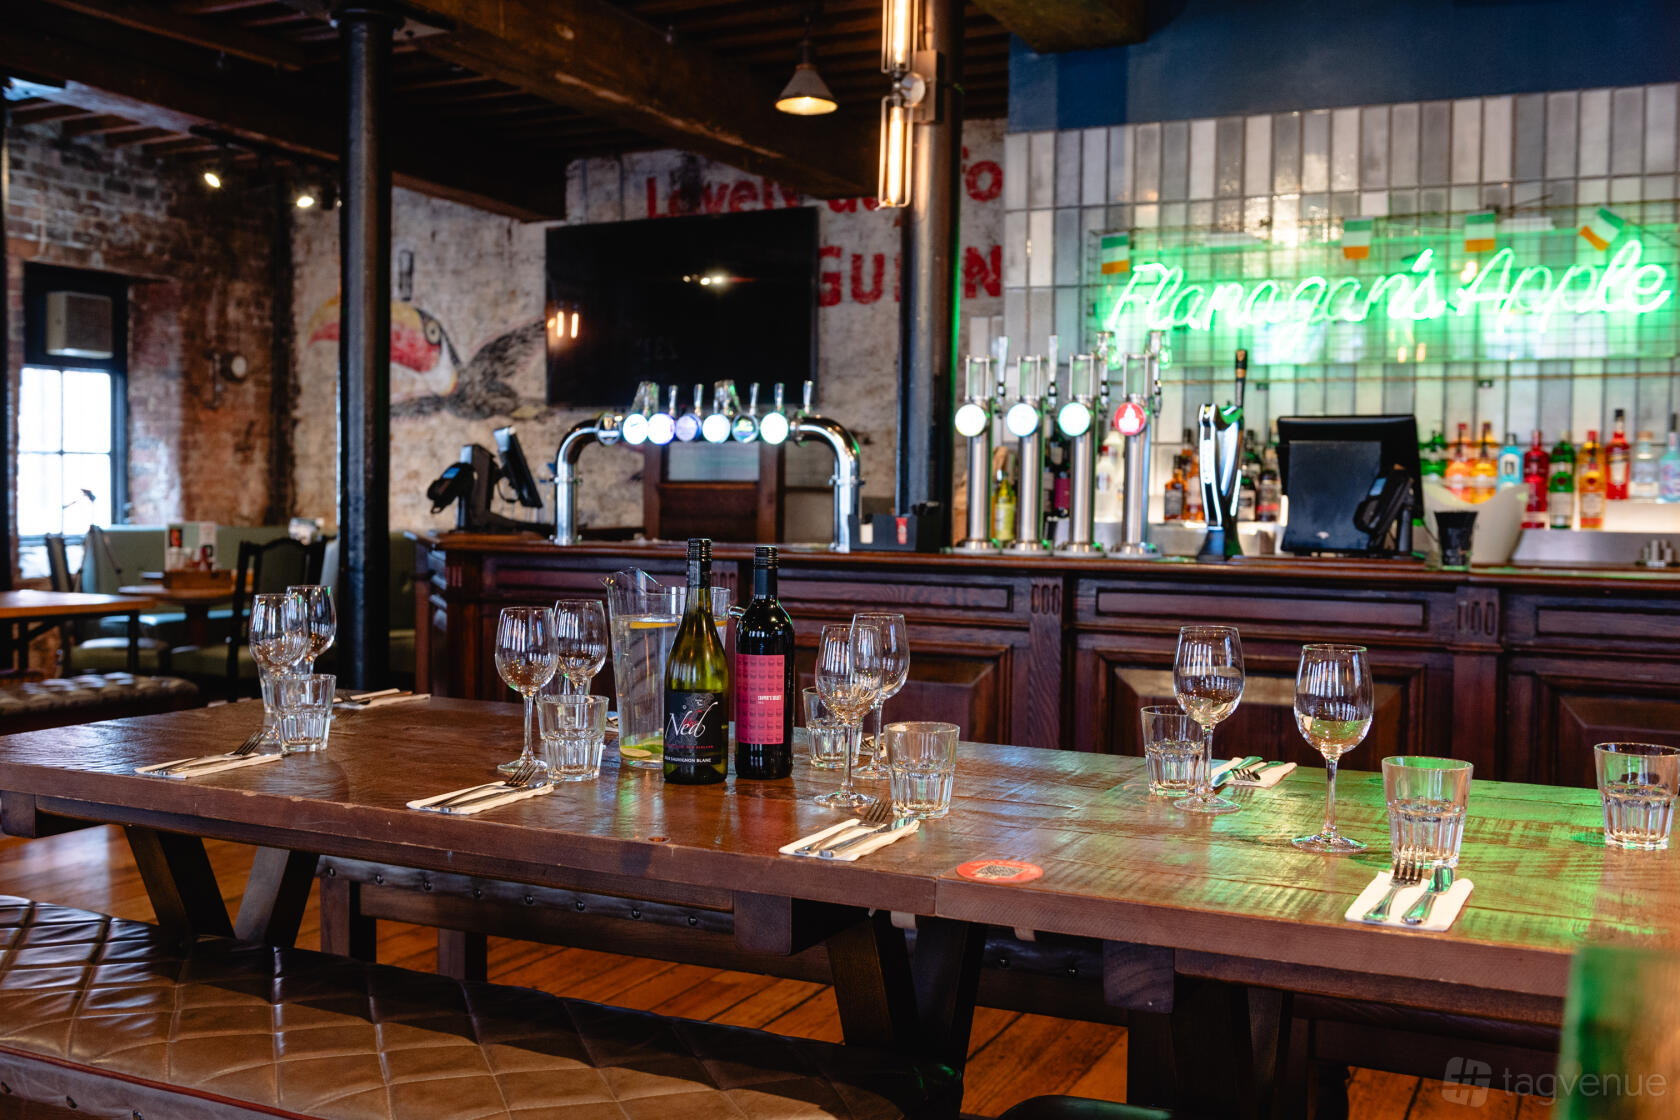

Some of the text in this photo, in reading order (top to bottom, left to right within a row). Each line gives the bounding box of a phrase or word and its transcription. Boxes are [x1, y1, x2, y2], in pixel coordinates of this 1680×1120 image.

[1106, 240, 1671, 333] Flanagan's Apple
[665, 701, 719, 739] Ned
